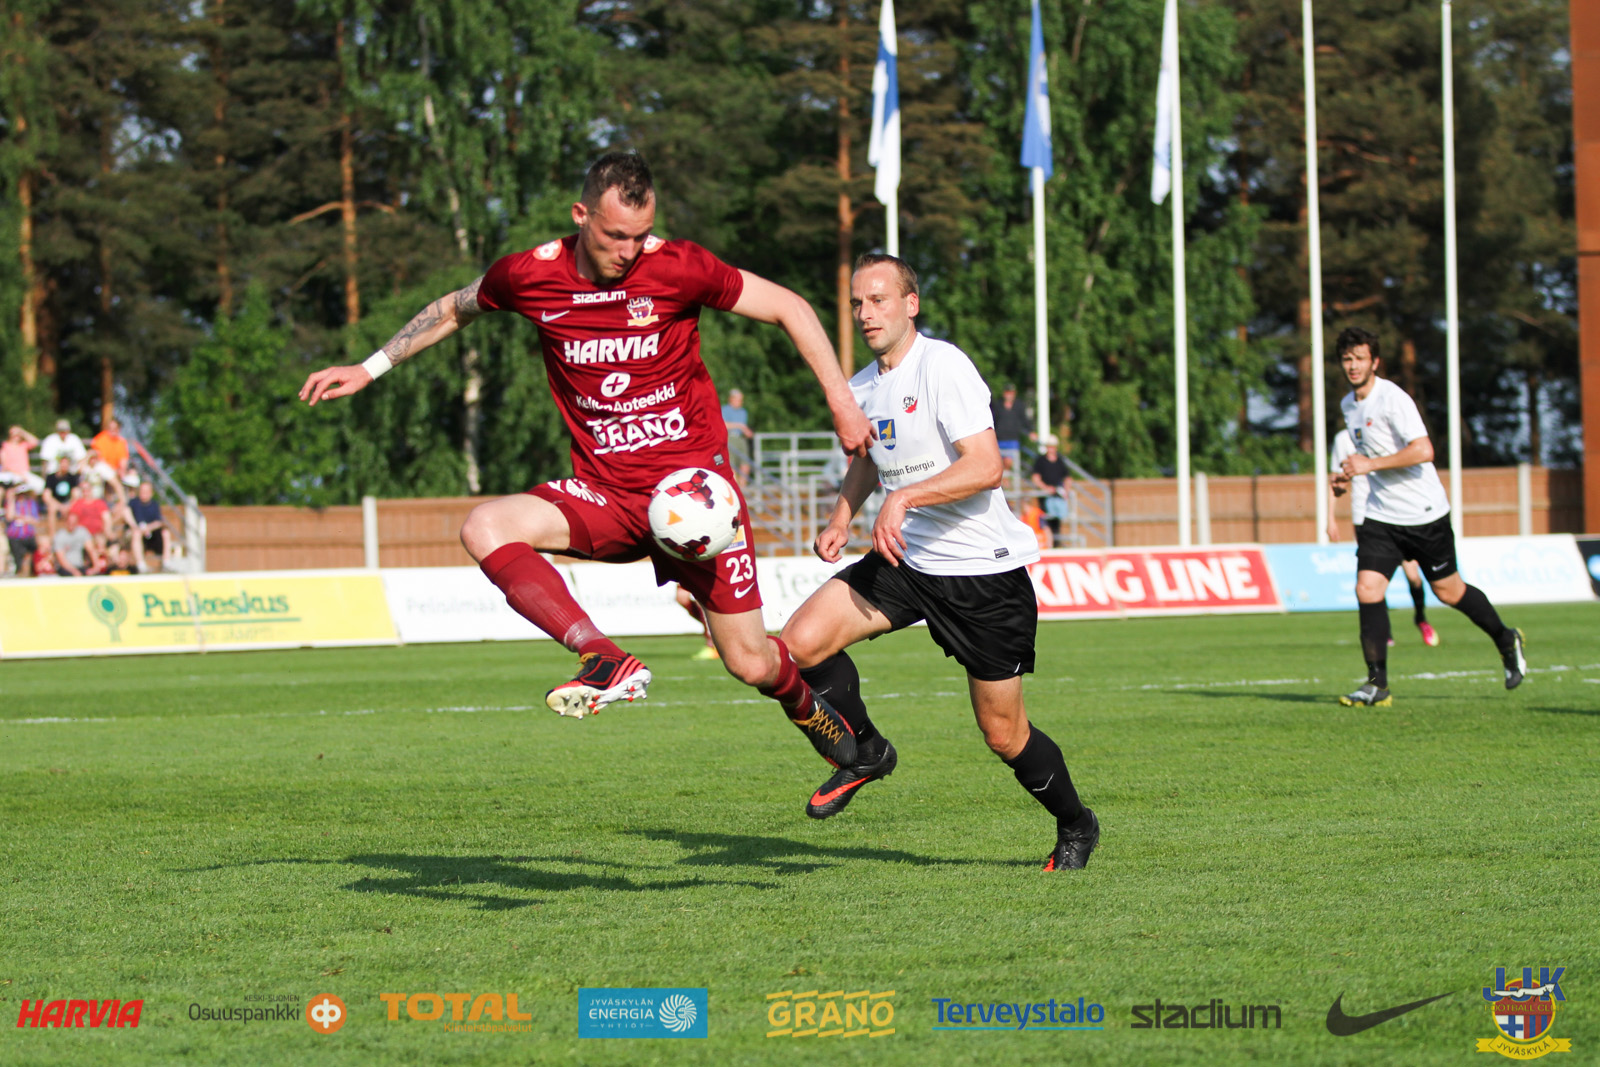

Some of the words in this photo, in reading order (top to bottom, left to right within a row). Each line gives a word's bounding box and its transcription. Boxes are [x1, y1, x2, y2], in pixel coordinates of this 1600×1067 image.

[573, 291, 626, 304] stadium
[564, 333, 660, 364] HARVIA
[613, 382, 676, 413] Apteekki
[593, 413, 685, 447] GRANO
[905, 460, 935, 472] Energia
[726, 554, 754, 584] 23
[1147, 557, 1260, 601] LINE
